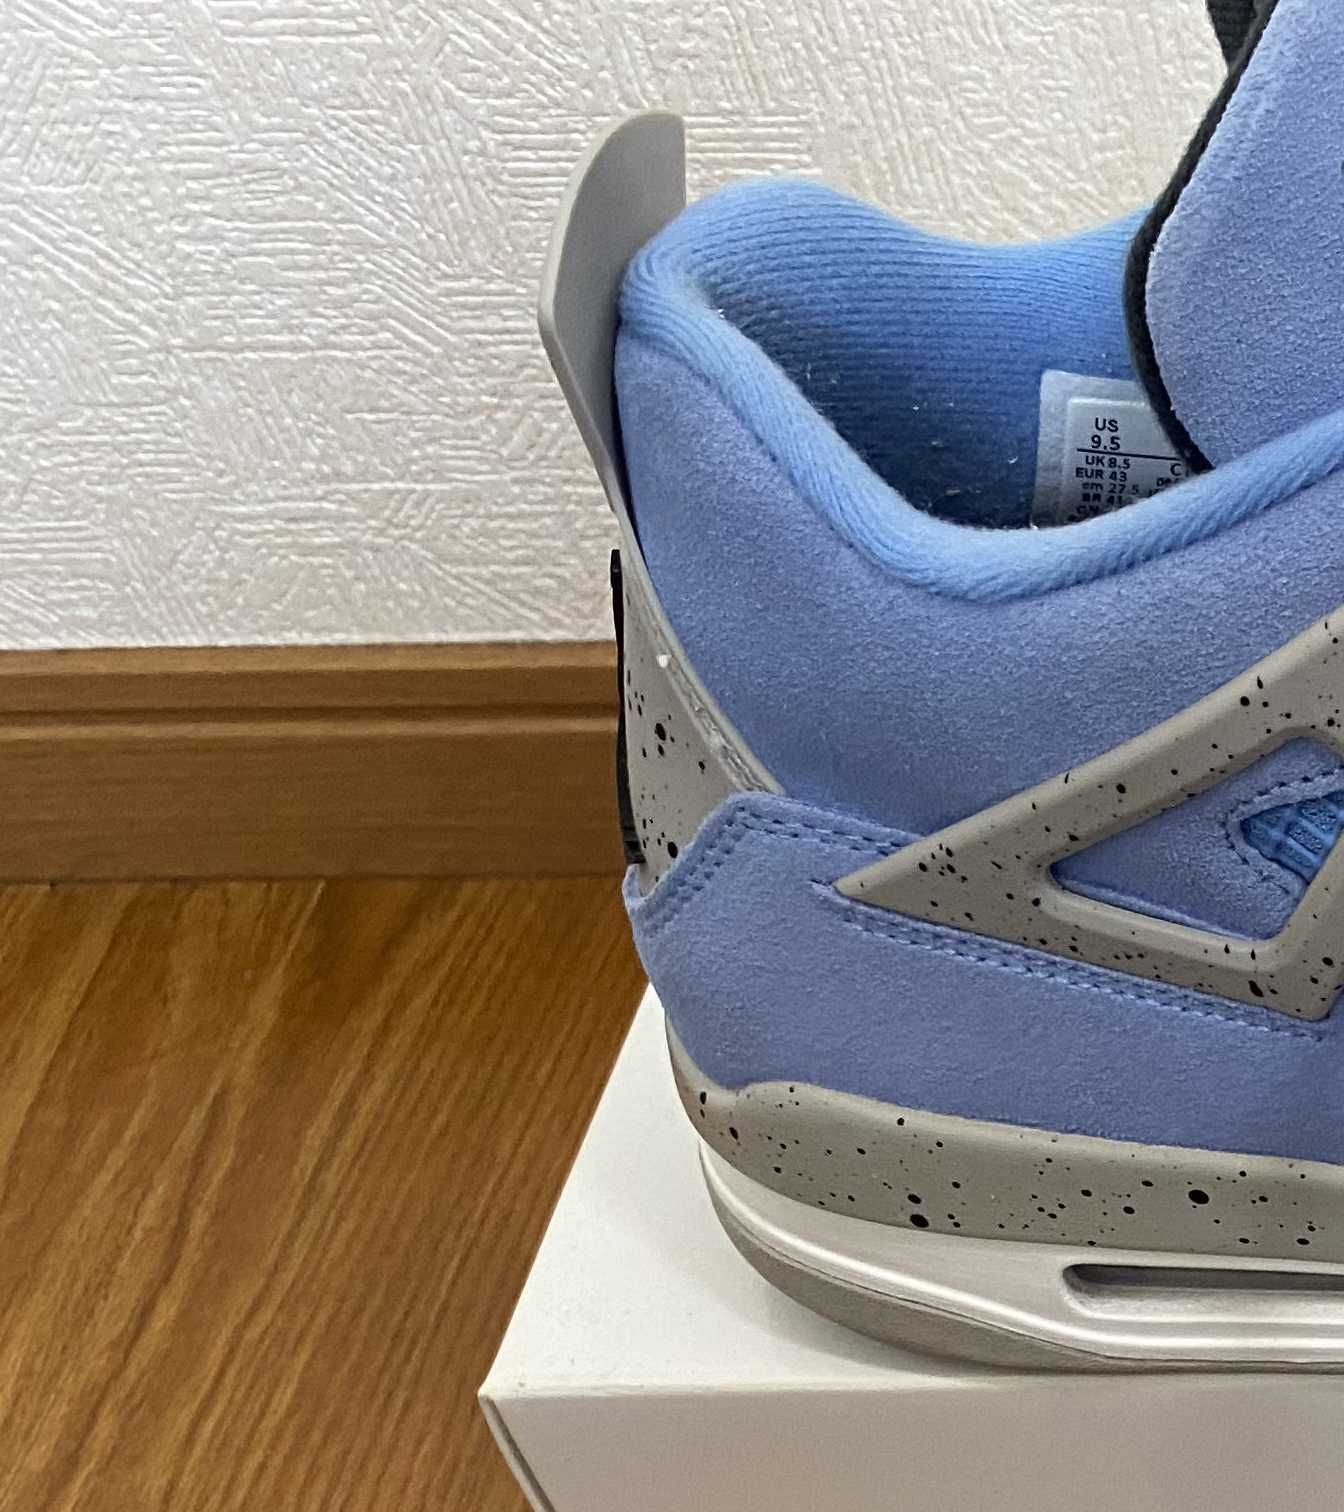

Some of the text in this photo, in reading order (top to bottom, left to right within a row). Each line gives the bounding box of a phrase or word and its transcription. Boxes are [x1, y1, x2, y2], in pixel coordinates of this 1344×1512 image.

[1095, 417, 1119, 432] US
[1091, 434, 1121, 450] 9.5
[1085, 455, 1131, 470] UK 8.5
[1075, 467, 1128, 482] EUR 43
